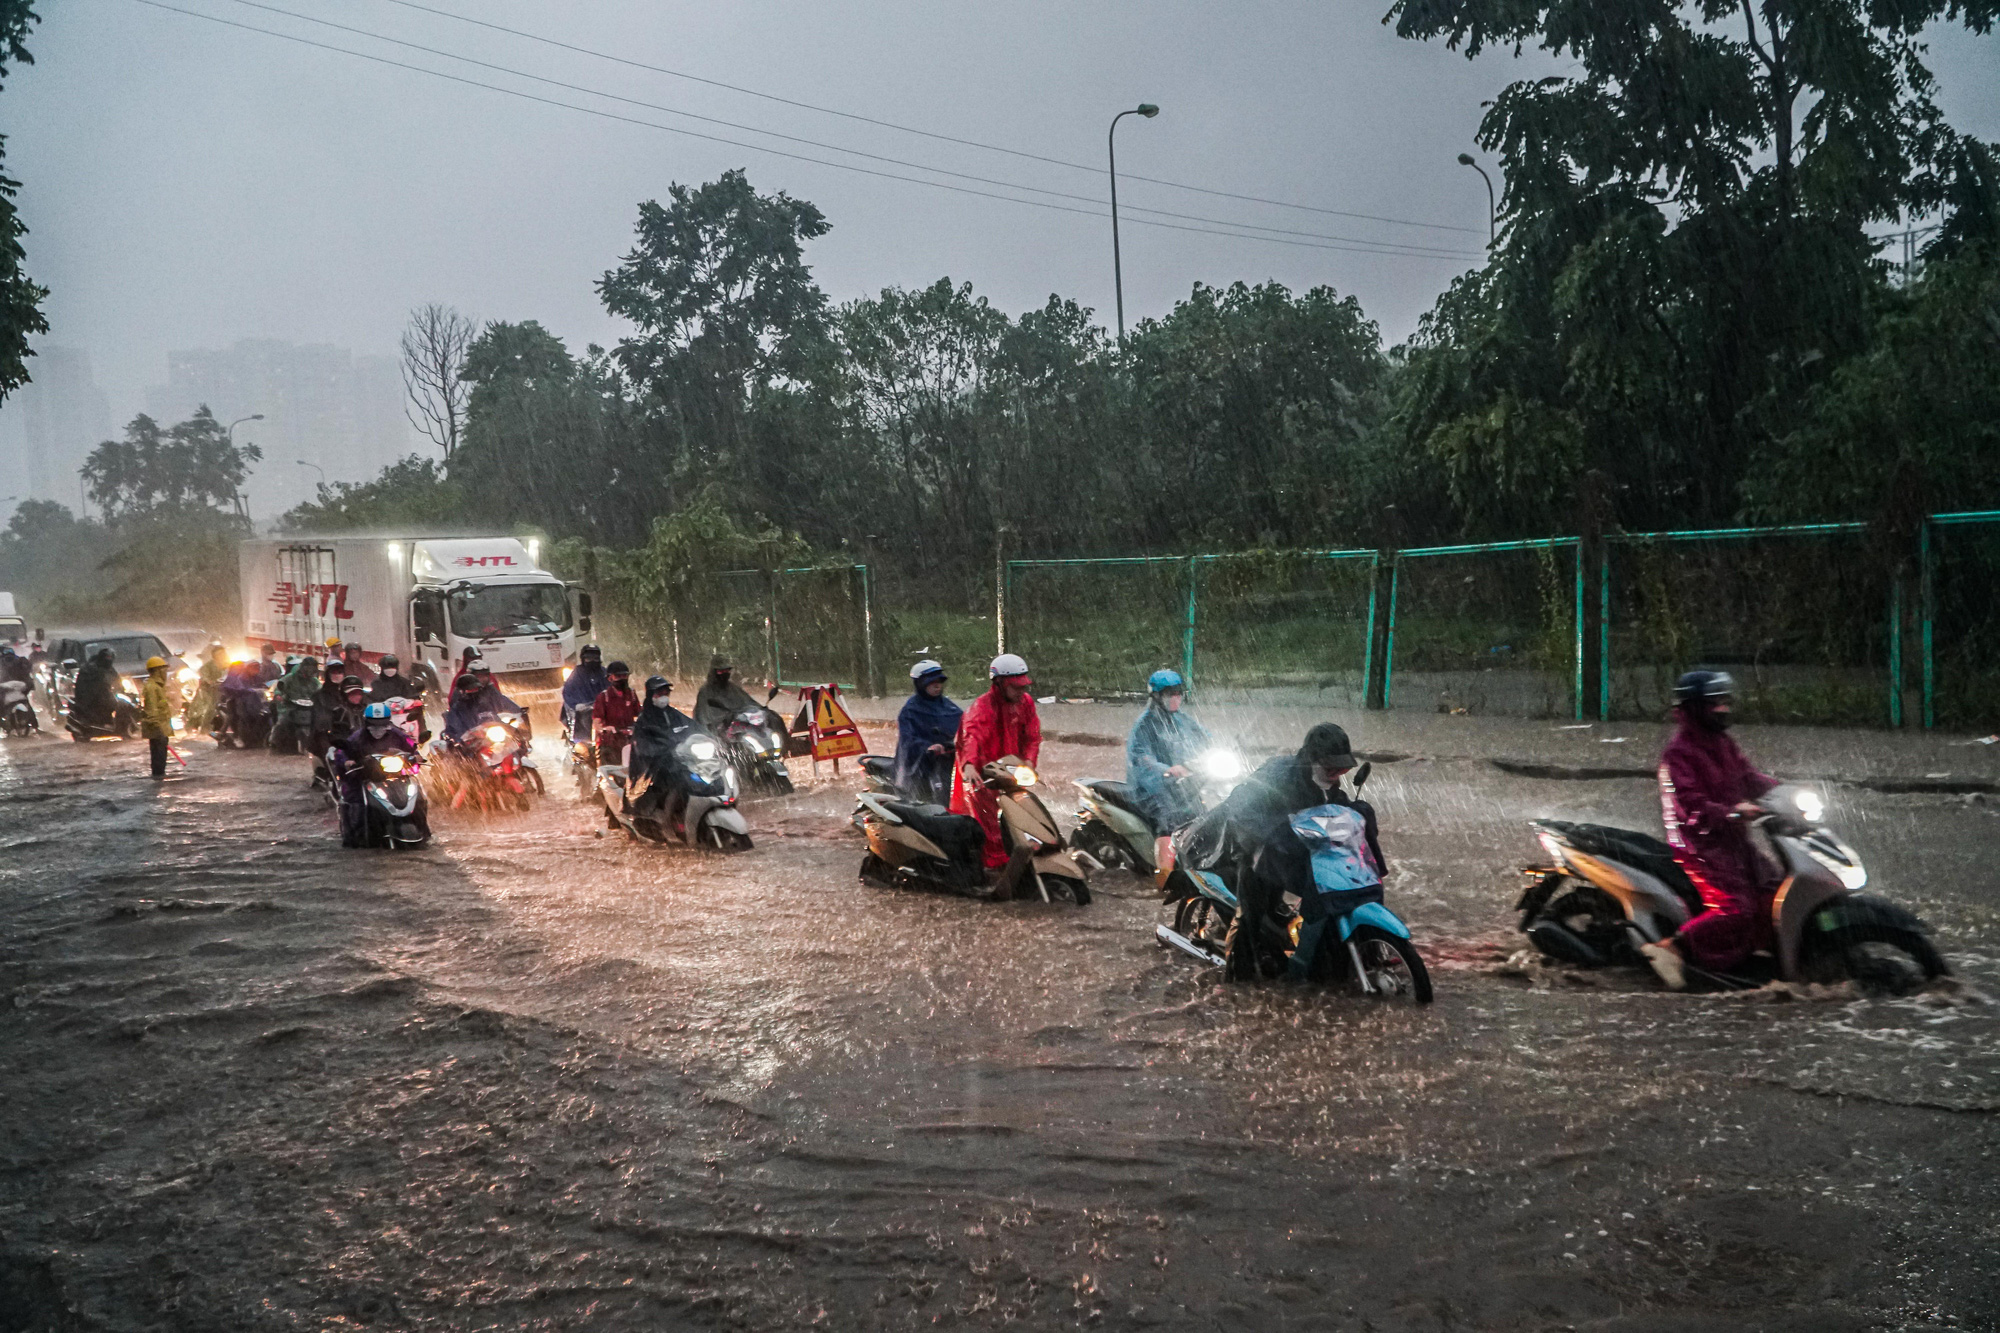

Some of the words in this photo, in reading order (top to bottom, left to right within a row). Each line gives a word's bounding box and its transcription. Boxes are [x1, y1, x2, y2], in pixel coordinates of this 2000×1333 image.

[457, 556, 518, 567] HTL
[269, 582, 354, 619] HTL
[506, 660, 540, 670] ISUZU
